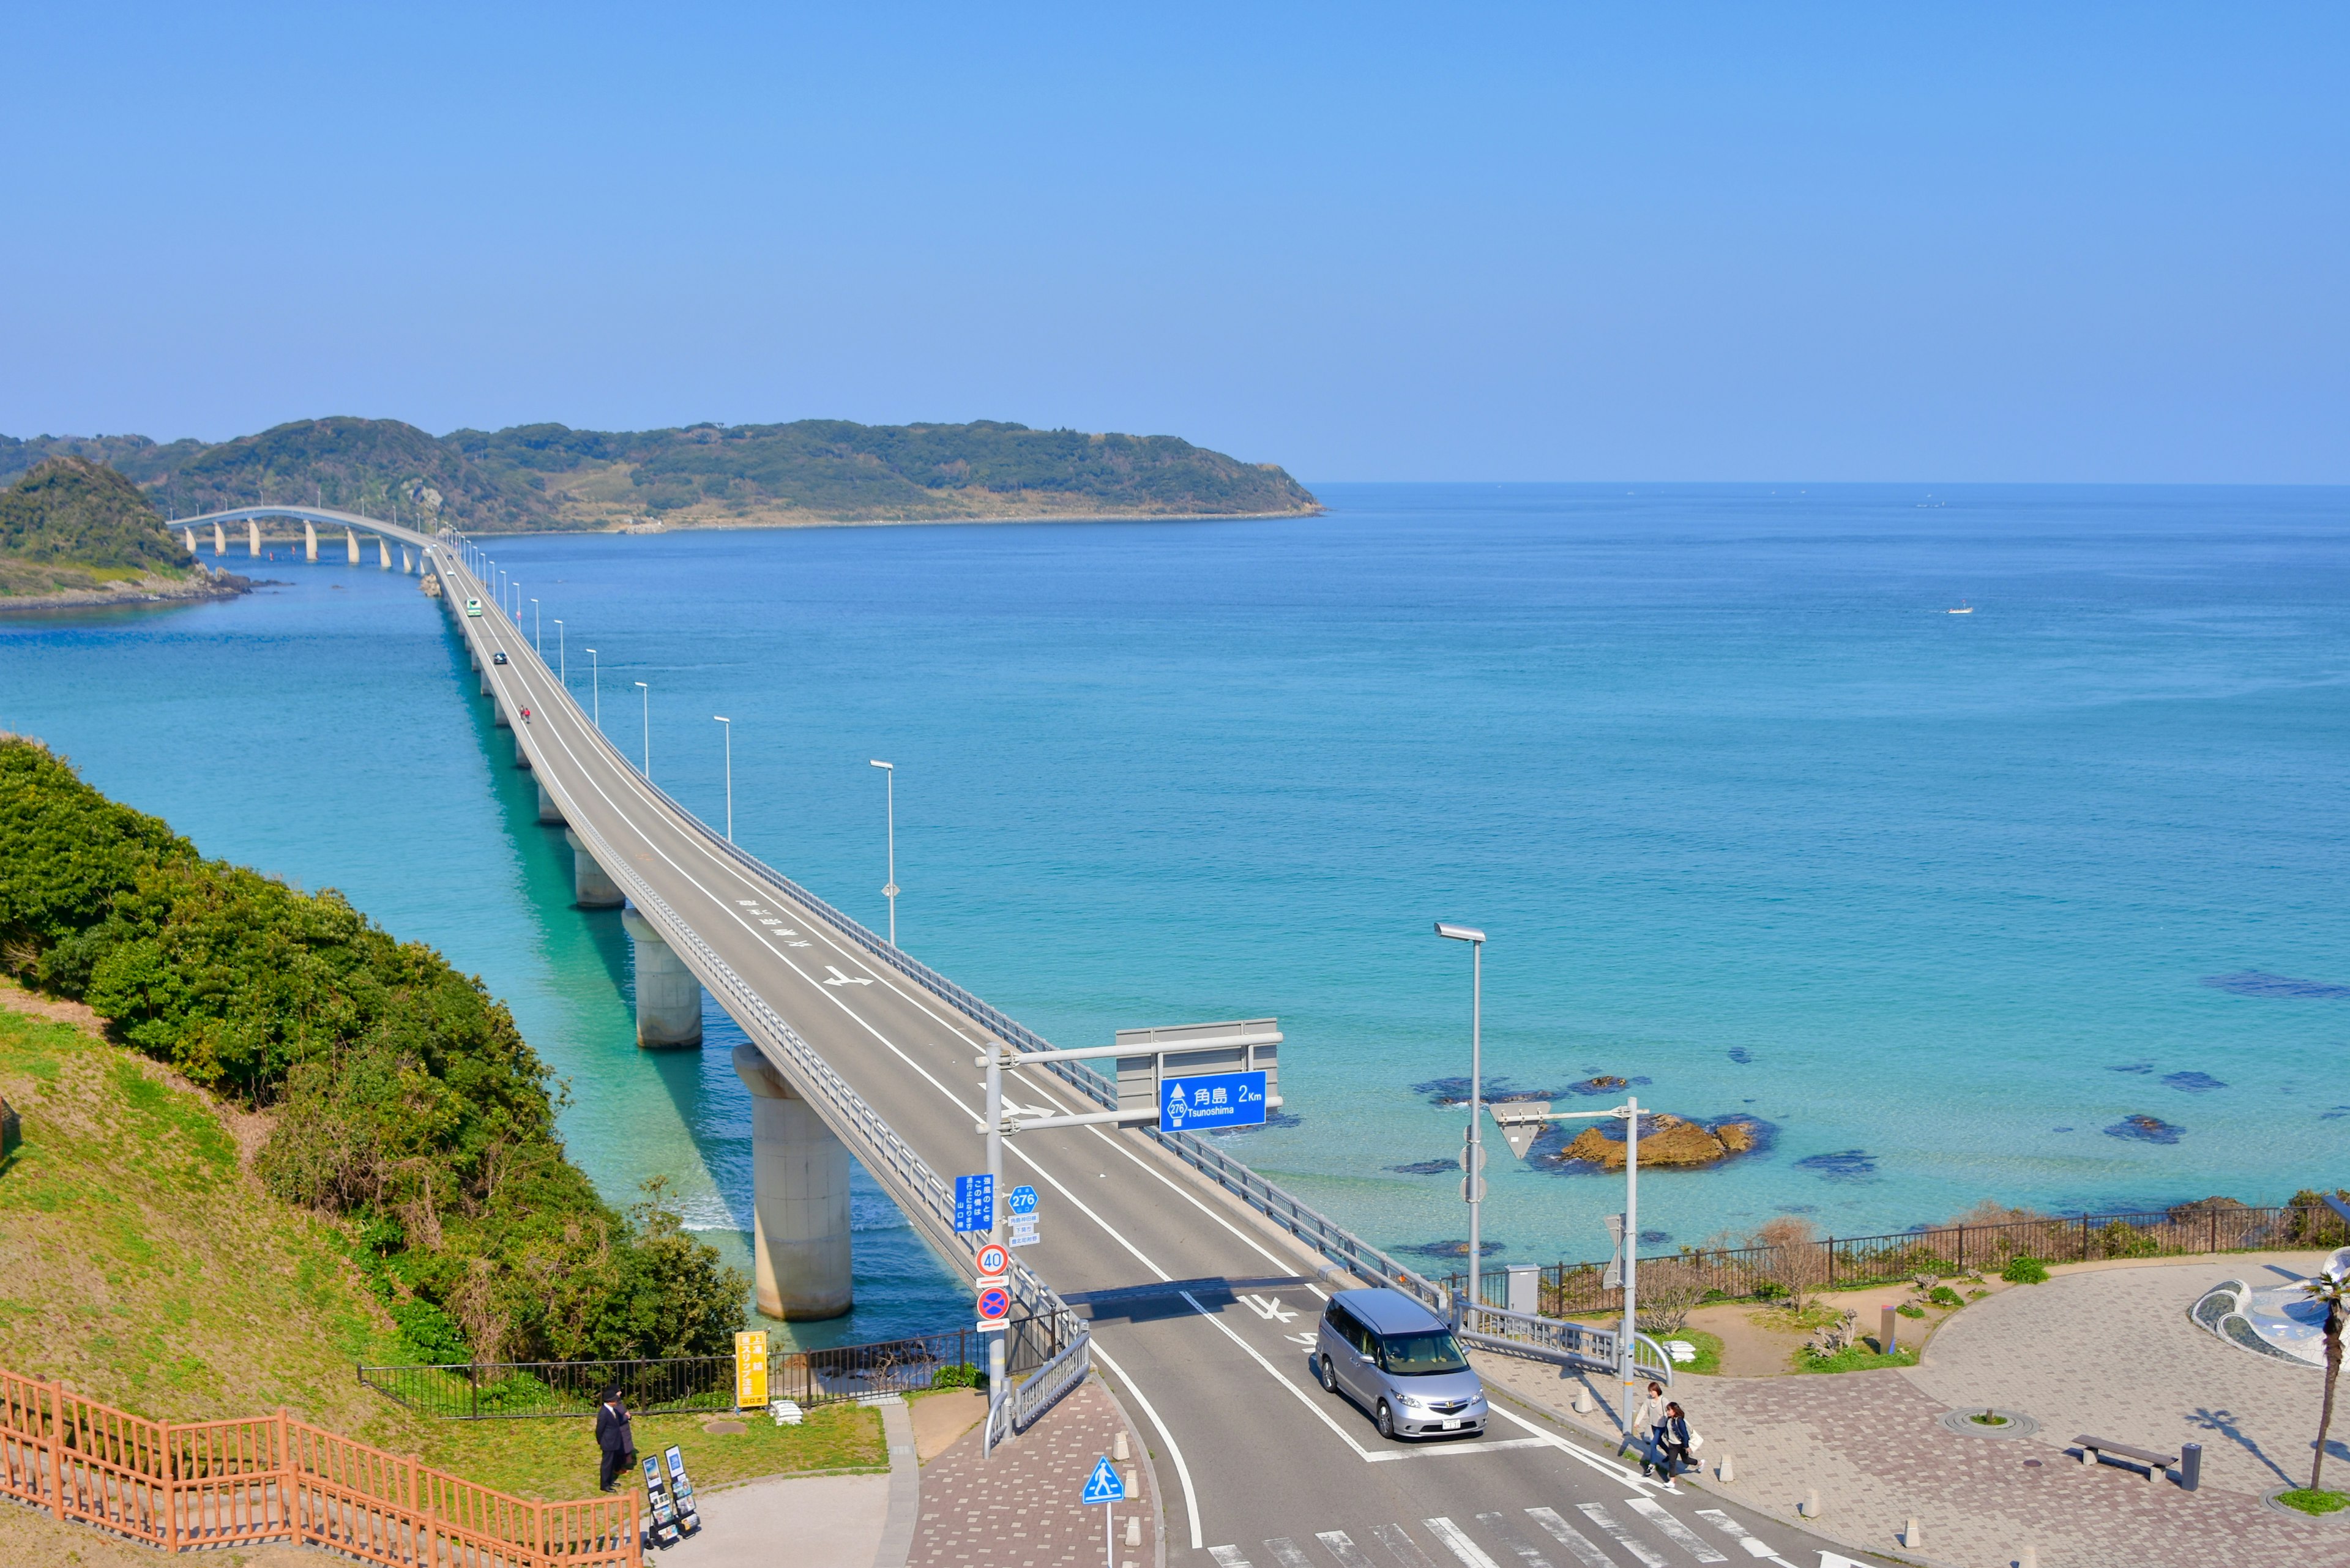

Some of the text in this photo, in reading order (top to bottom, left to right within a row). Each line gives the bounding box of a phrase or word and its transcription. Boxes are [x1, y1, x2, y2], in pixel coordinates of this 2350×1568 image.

[1194, 1086, 1228, 1106] 角島
[1171, 1103, 1184, 1114] 276
[1187, 1106, 1234, 1118] Tsunoshima
[1012, 1194, 1035, 1207] 276
[983, 1253, 1001, 1267] 40
[741, 1346, 752, 1395] スリップ注意
